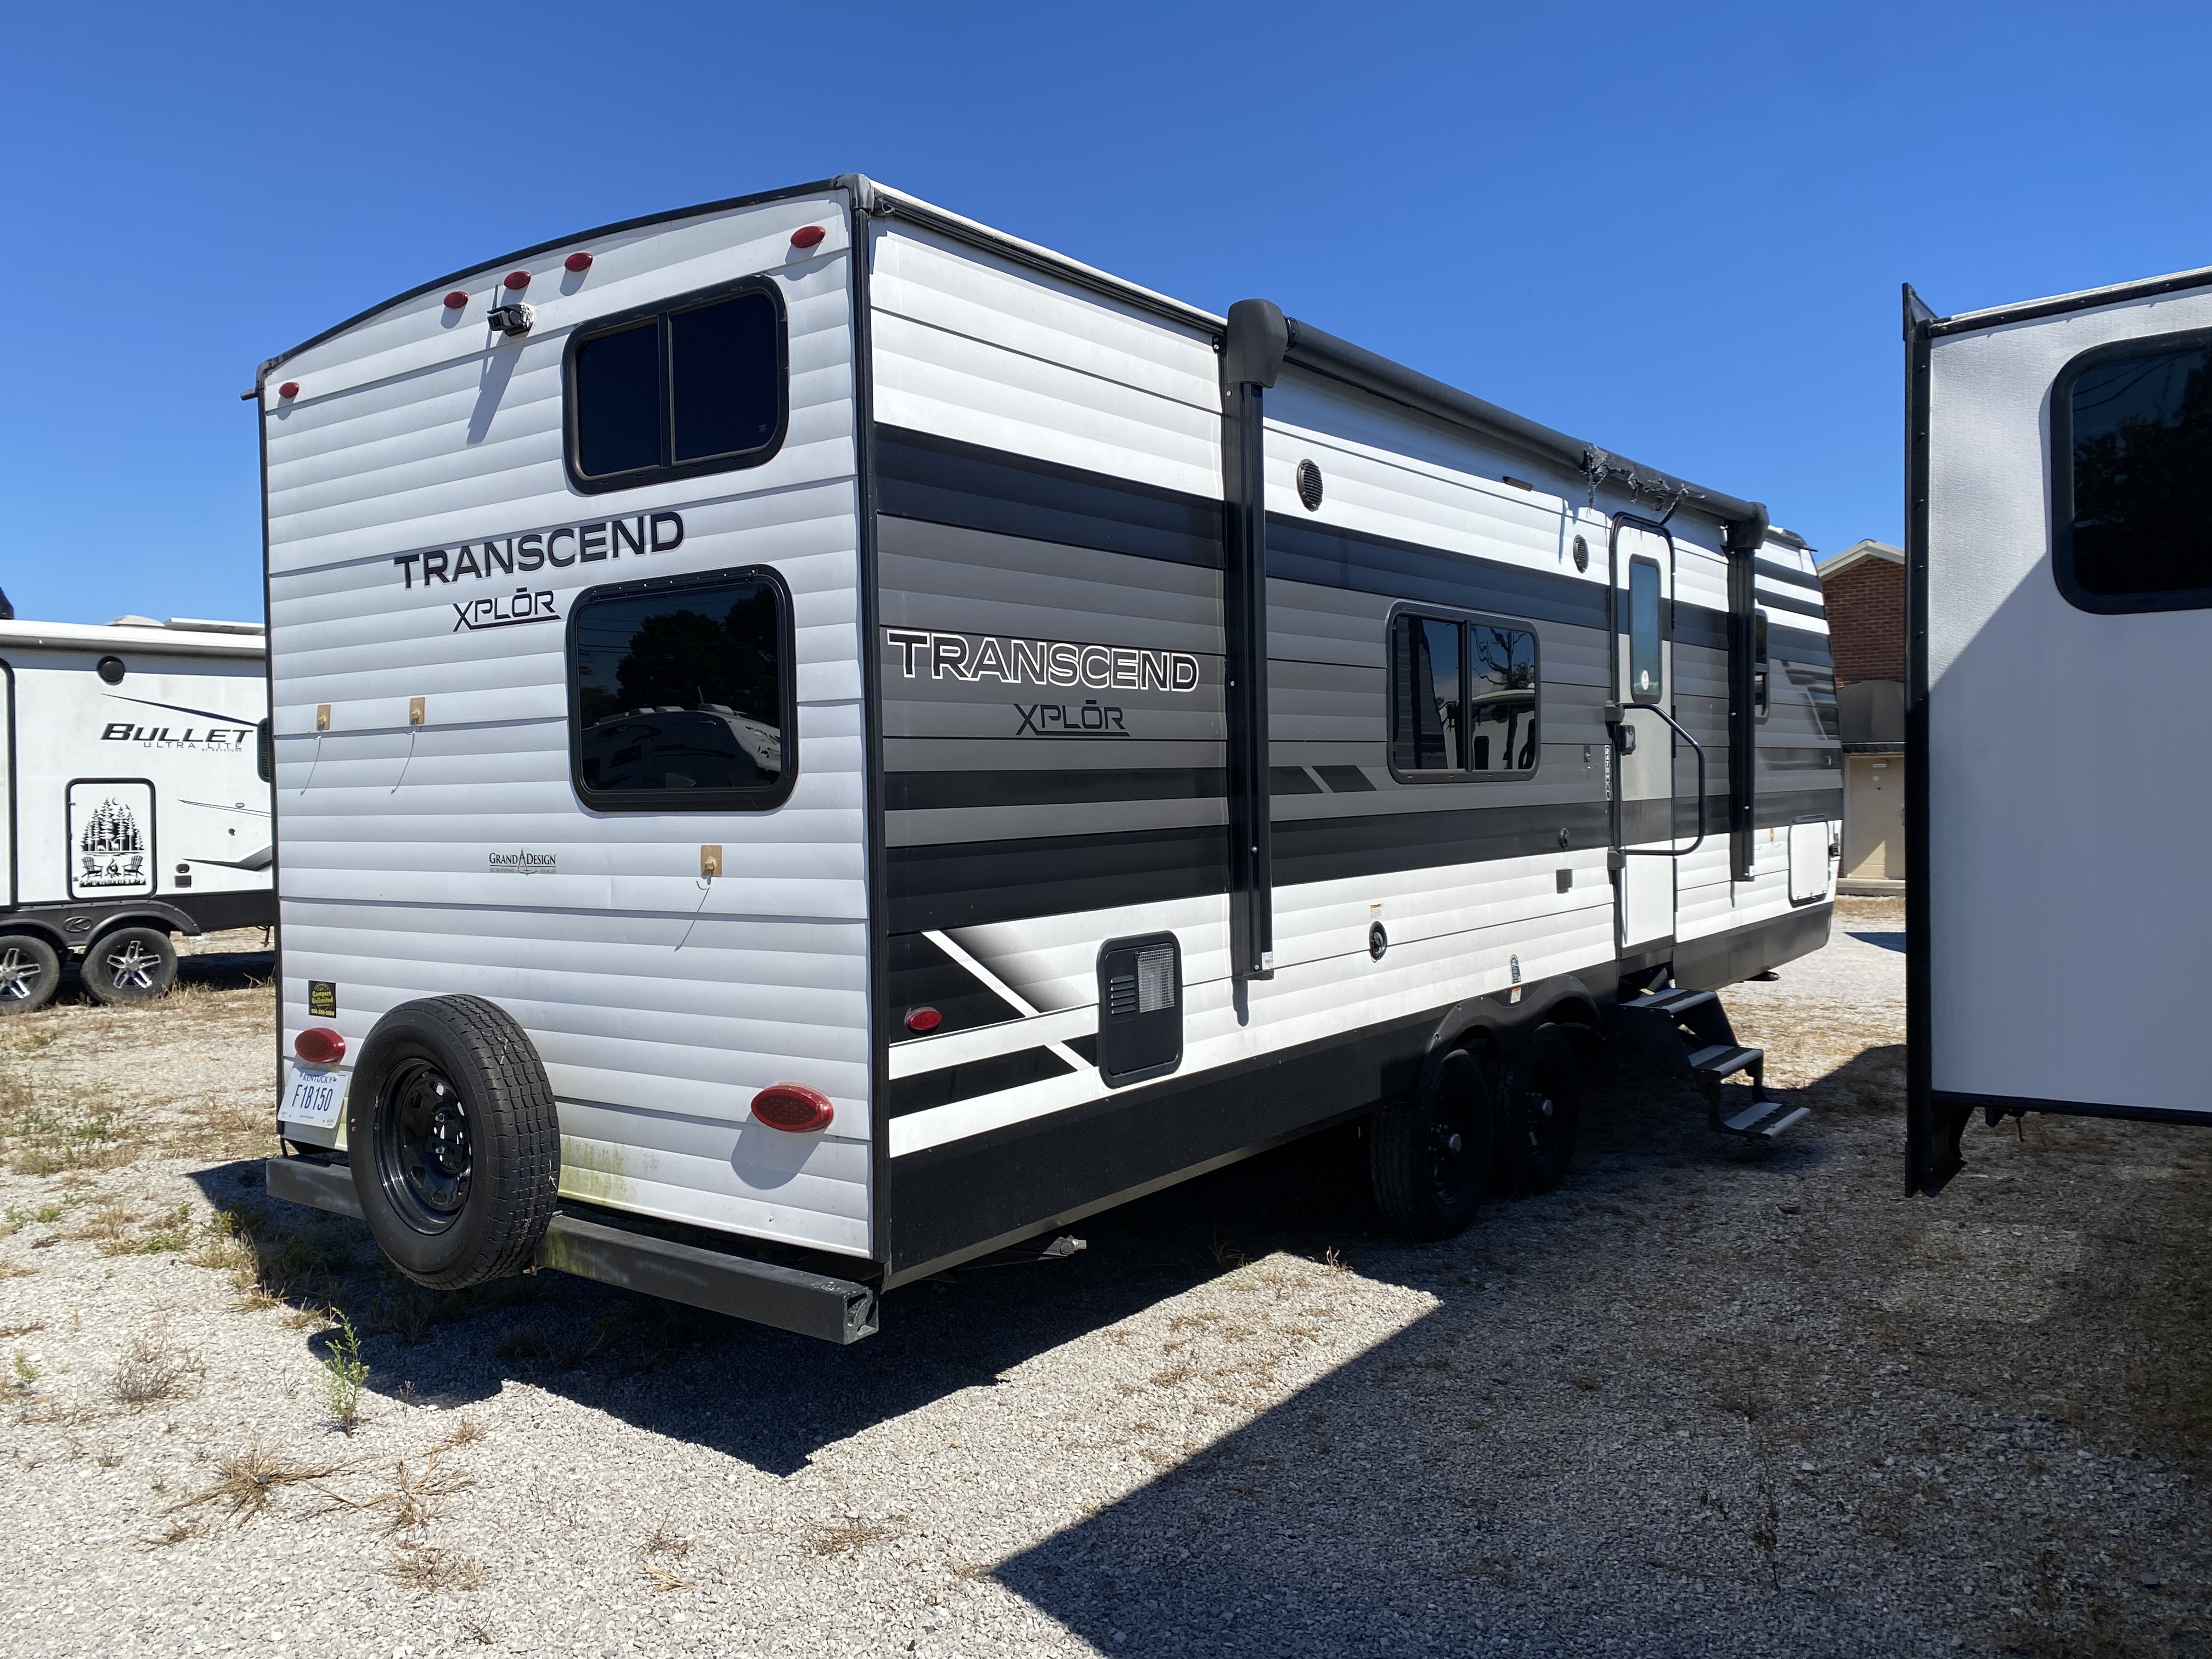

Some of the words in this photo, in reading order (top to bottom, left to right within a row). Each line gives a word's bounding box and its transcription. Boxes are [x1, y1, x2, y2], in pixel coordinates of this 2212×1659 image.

[393, 511, 685, 590] TRANSCEND
[887, 629, 1199, 692] TRANSCEND
[100, 723, 254, 743] BULLET
[489, 853, 518, 864] GRAND
[526, 853, 556, 865] DESIGN
[302, 1073, 333, 1085] KENTUCKY
